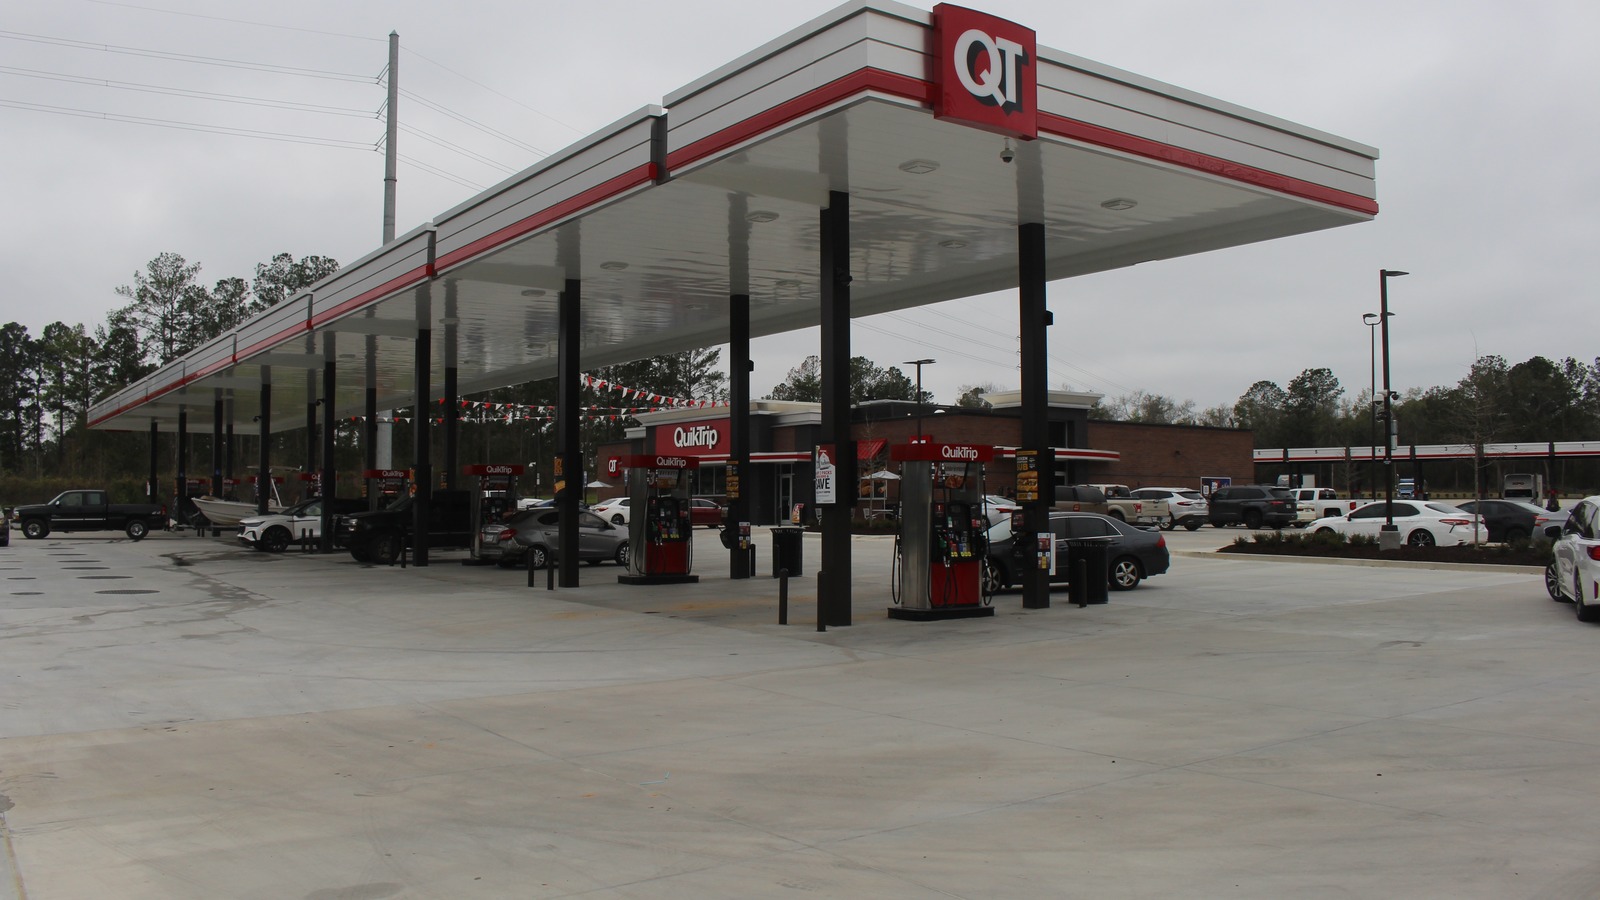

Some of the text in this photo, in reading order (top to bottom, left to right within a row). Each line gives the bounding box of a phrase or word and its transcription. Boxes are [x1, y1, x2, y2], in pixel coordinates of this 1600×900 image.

[954, 29, 1024, 108] QT
[674, 425, 718, 449] QuikTrip
[942, 445, 978, 461] QuikTrip
[608, 459, 617, 473] QT
[656, 456, 687, 467] QuikTrip
[381, 470, 405, 478] QuikTrip
[486, 465, 512, 475] QuikTrip
